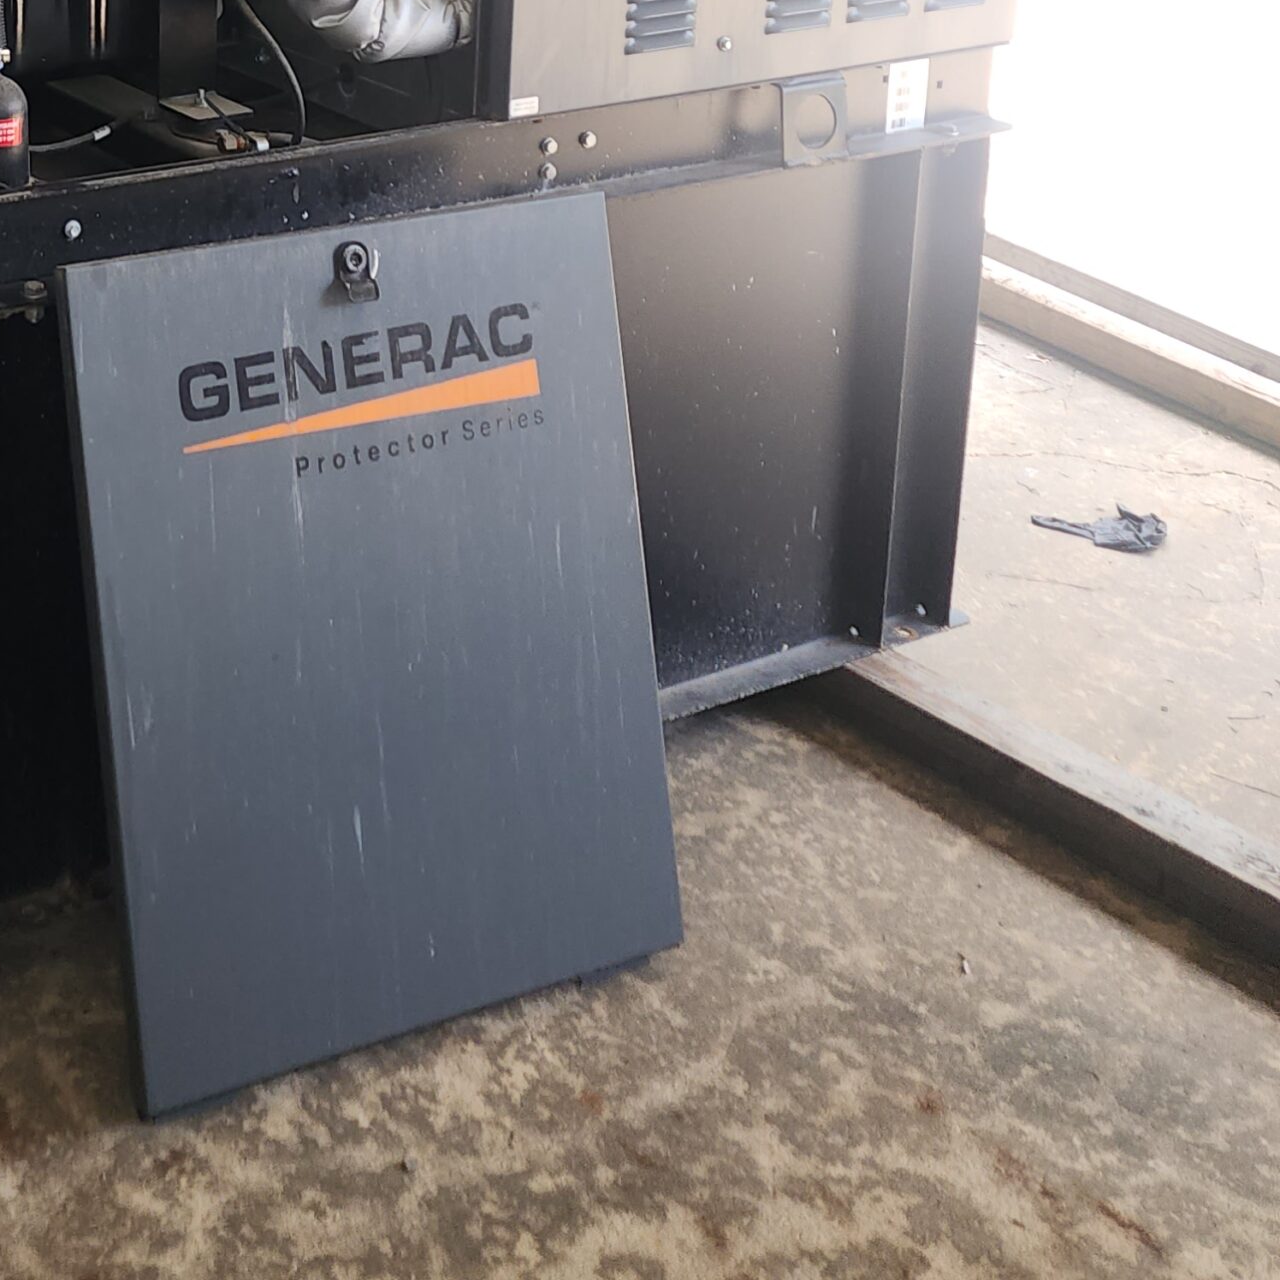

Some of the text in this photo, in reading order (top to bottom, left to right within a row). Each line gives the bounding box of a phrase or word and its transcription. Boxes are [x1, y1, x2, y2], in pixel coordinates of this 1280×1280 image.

[178, 302, 534, 422] GENERAC
[295, 407, 545, 478] Protector Series
